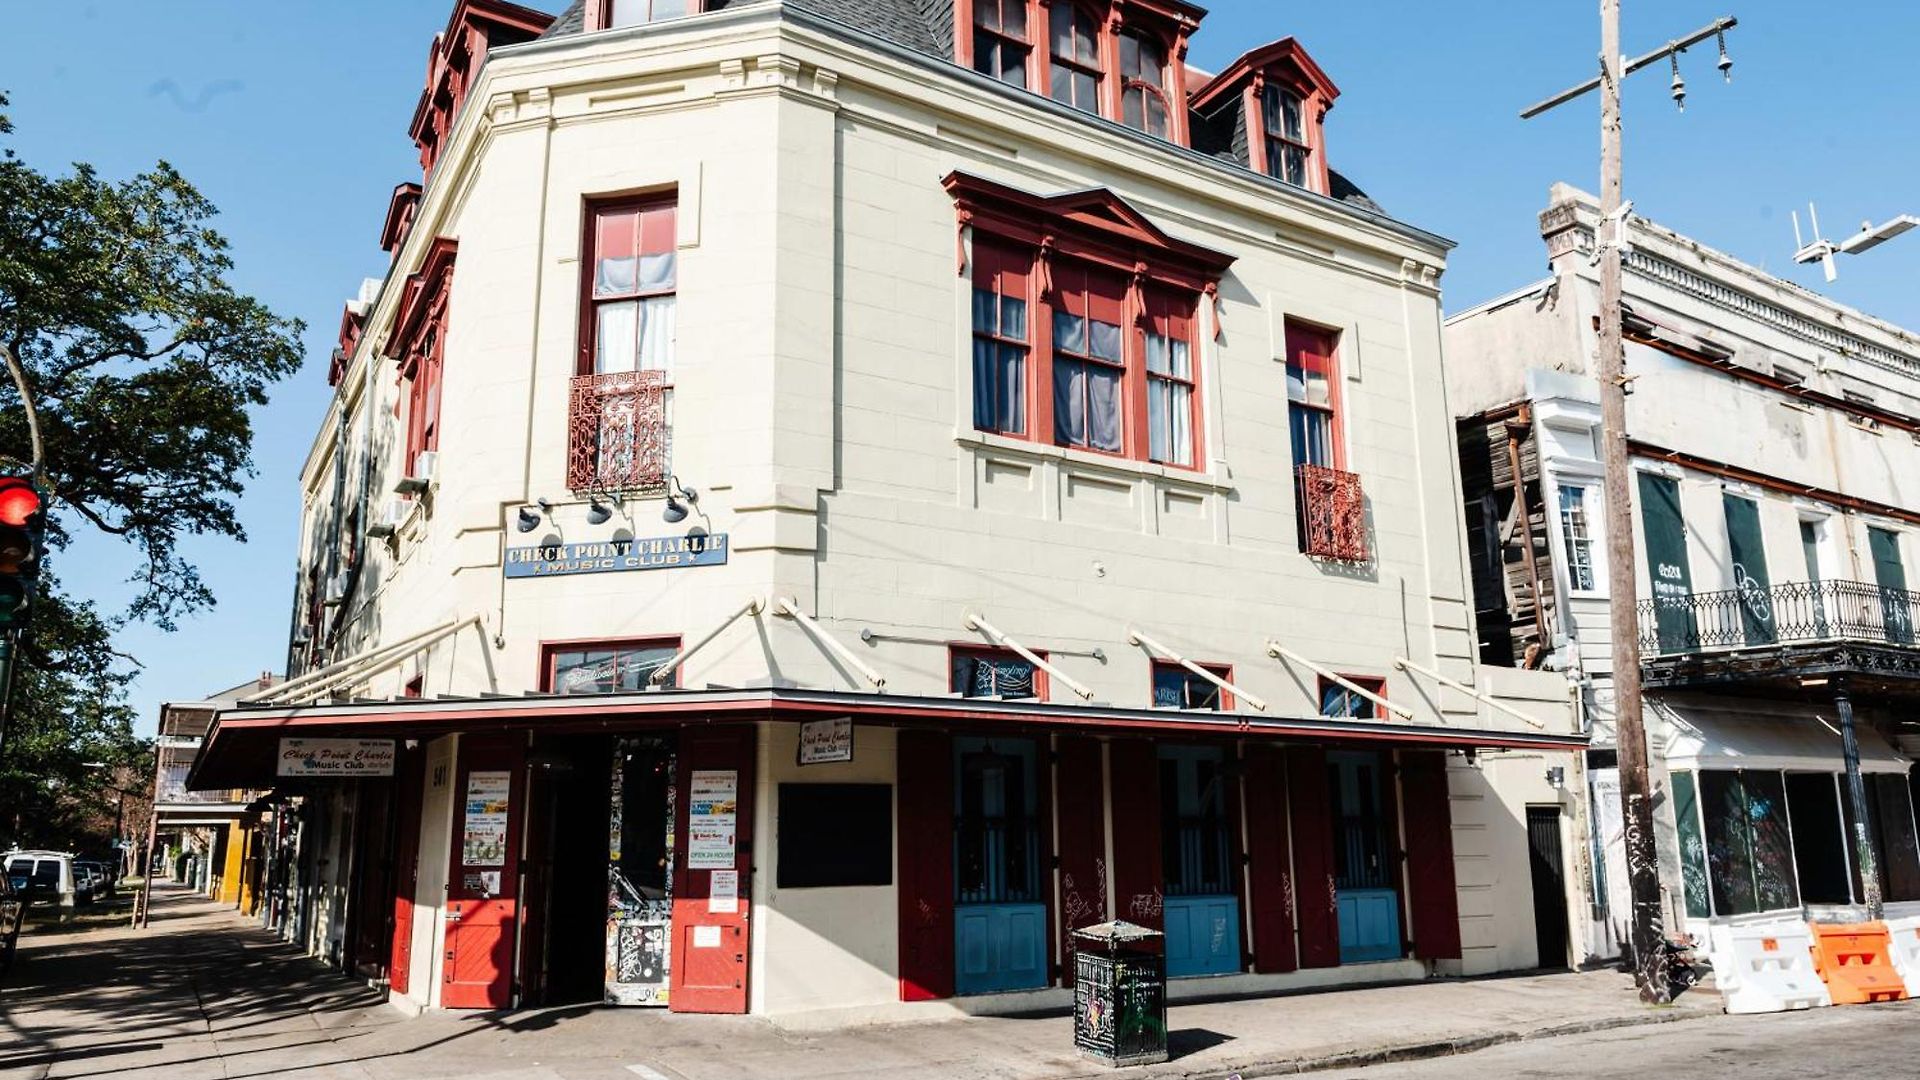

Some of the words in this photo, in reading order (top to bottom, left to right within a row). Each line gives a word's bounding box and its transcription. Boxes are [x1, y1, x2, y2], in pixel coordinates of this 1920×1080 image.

[508, 546, 568, 563] CHECK
[575, 542, 632, 560] POINT
[638, 535, 723, 555] CHARLIE
[548, 560, 615, 572] MUSIC
[625, 555, 681, 568] CLUB
[313, 760, 340, 769] Music
[344, 760, 364, 769] Club
